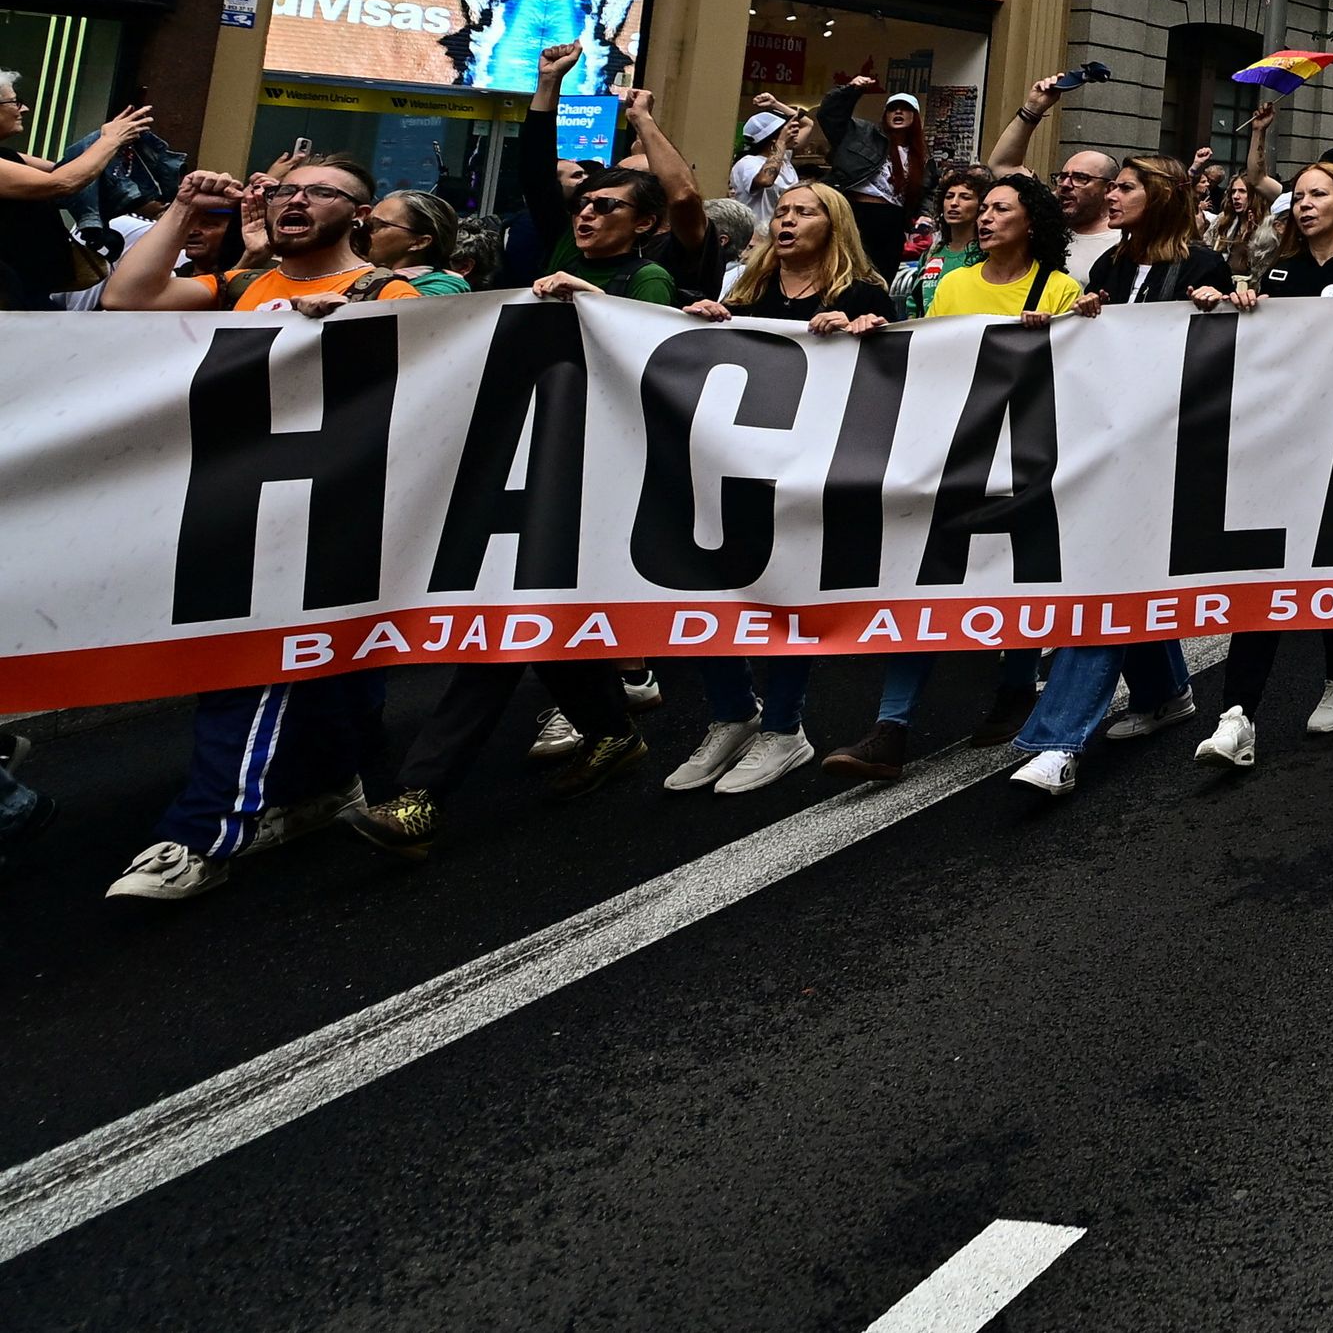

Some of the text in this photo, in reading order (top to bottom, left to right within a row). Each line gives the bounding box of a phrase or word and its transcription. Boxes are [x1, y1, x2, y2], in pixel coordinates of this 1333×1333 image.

[286, 90, 359, 104] Western Union
[410, 99, 474, 112] Western Union
[557, 104, 602, 117] Change
[556, 116, 595, 128] Money
[172, 302, 1063, 625] HACIA
[282, 612, 617, 670] BAJADA
[669, 611, 819, 644] DEL
[857, 593, 1231, 646] ALQUILER
